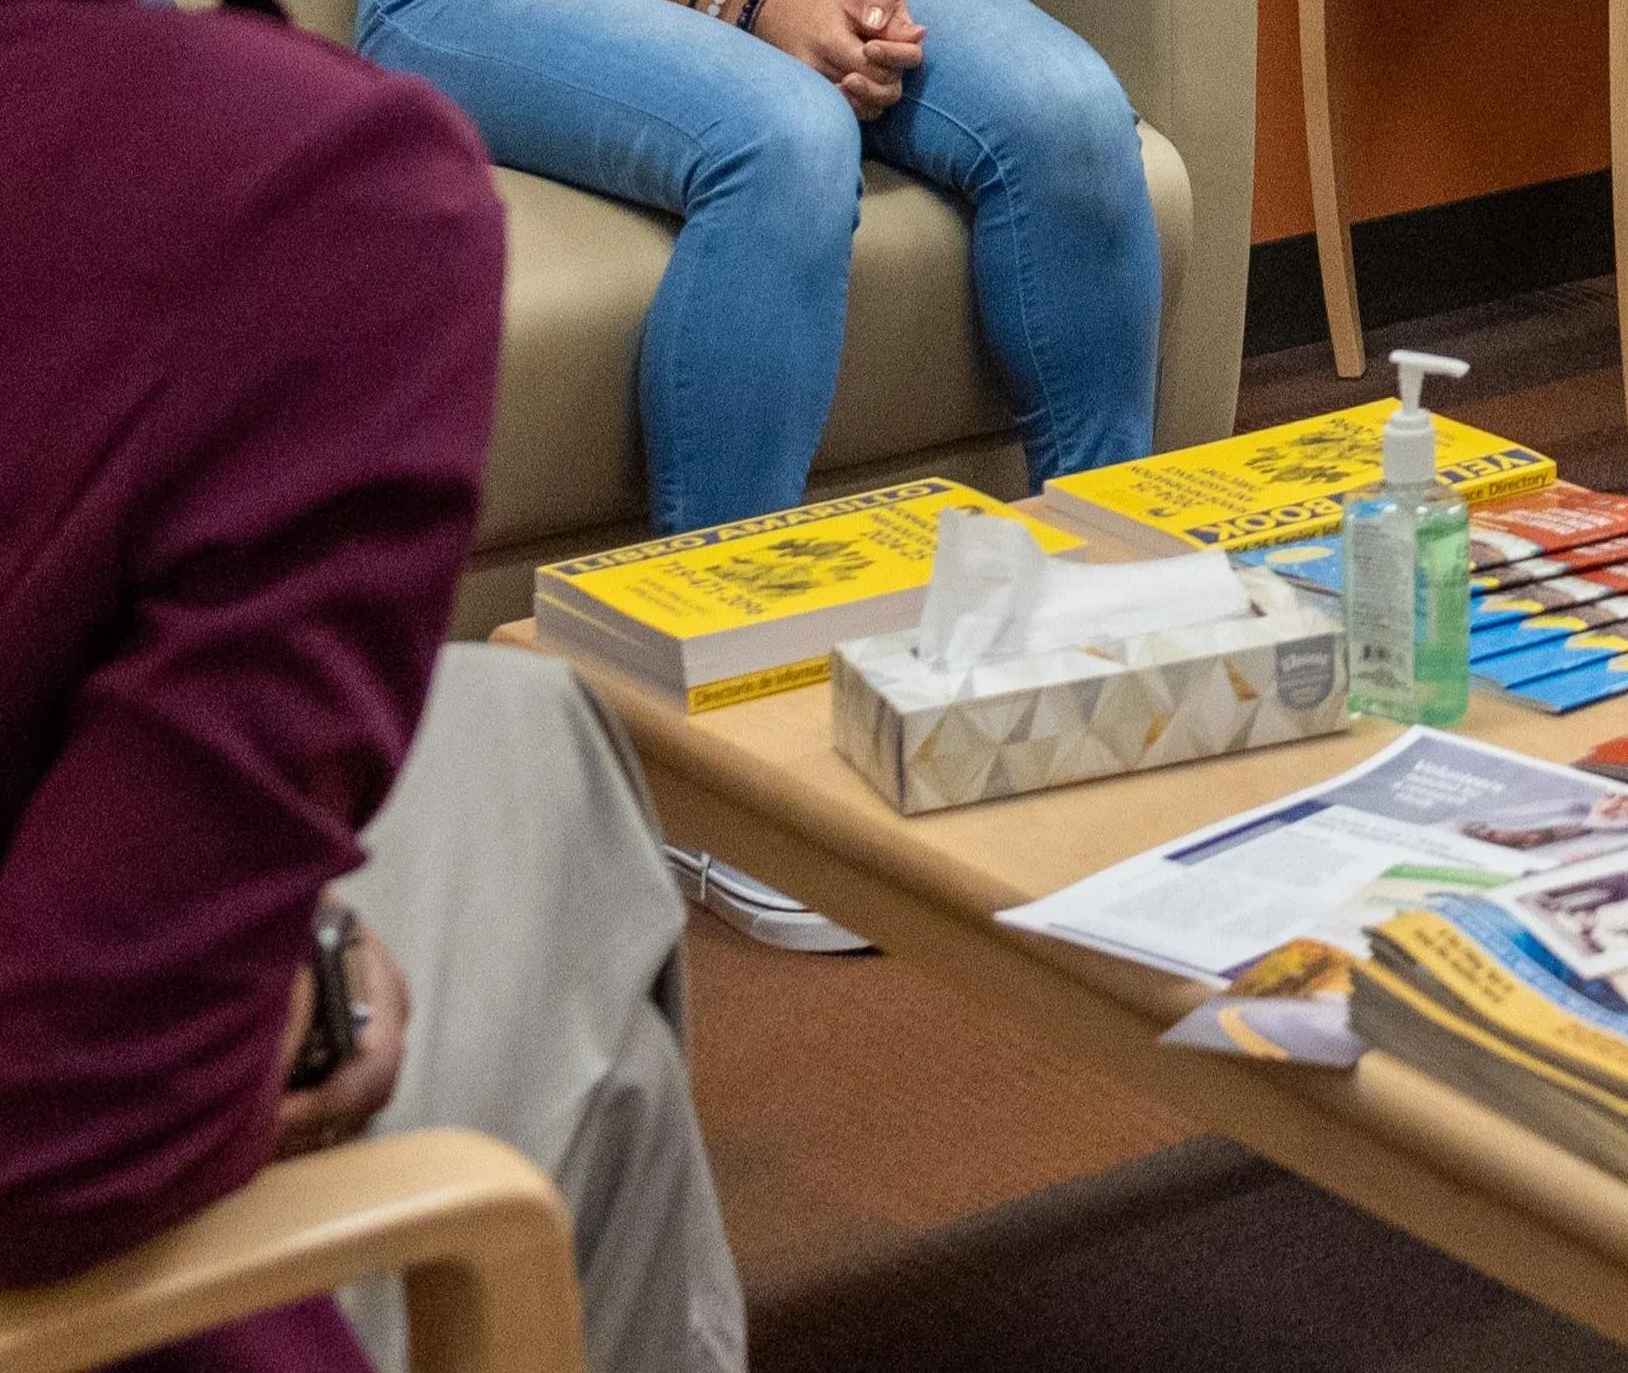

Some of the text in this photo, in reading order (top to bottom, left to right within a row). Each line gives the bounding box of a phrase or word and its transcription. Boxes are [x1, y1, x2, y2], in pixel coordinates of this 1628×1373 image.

[1438, 448, 1542, 485] YEL
[1489, 472, 1549, 496] Directory
[571, 533, 709, 574] LIBRO
[713, 482, 936, 543] AMARILLO
[1201, 497, 1344, 541] BOOK
